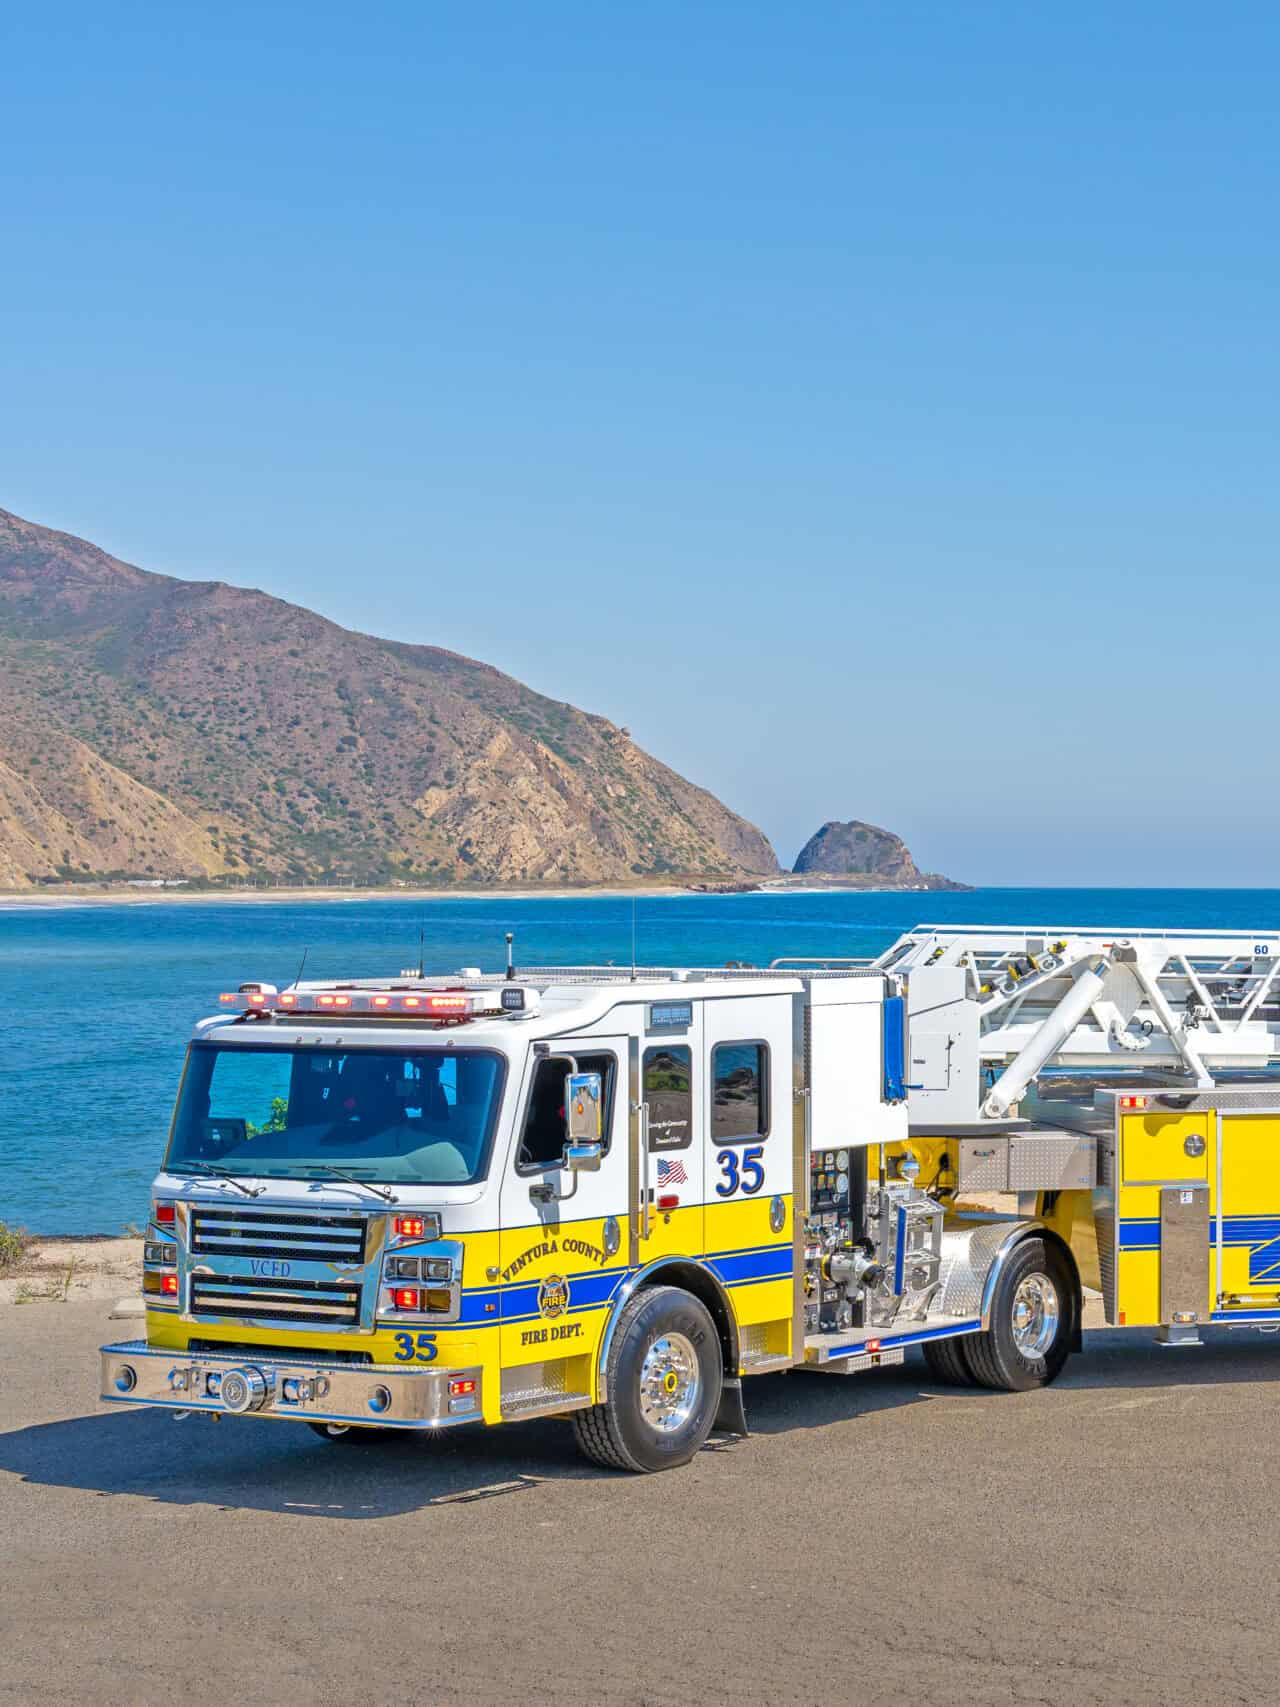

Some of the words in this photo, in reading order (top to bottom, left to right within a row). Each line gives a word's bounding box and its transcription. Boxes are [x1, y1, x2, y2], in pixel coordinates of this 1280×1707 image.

[1253, 944, 1269, 955] 60
[715, 1146, 765, 1198] 35
[250, 1259, 291, 1277] VCFD
[502, 1239, 559, 1282] VENTURA
[562, 1238, 609, 1267] COUNTY
[543, 1295, 567, 1307] FIRE
[521, 1328, 548, 1346] FIRE
[551, 1322, 585, 1341] DEPT.
[394, 1333, 438, 1361] 35
